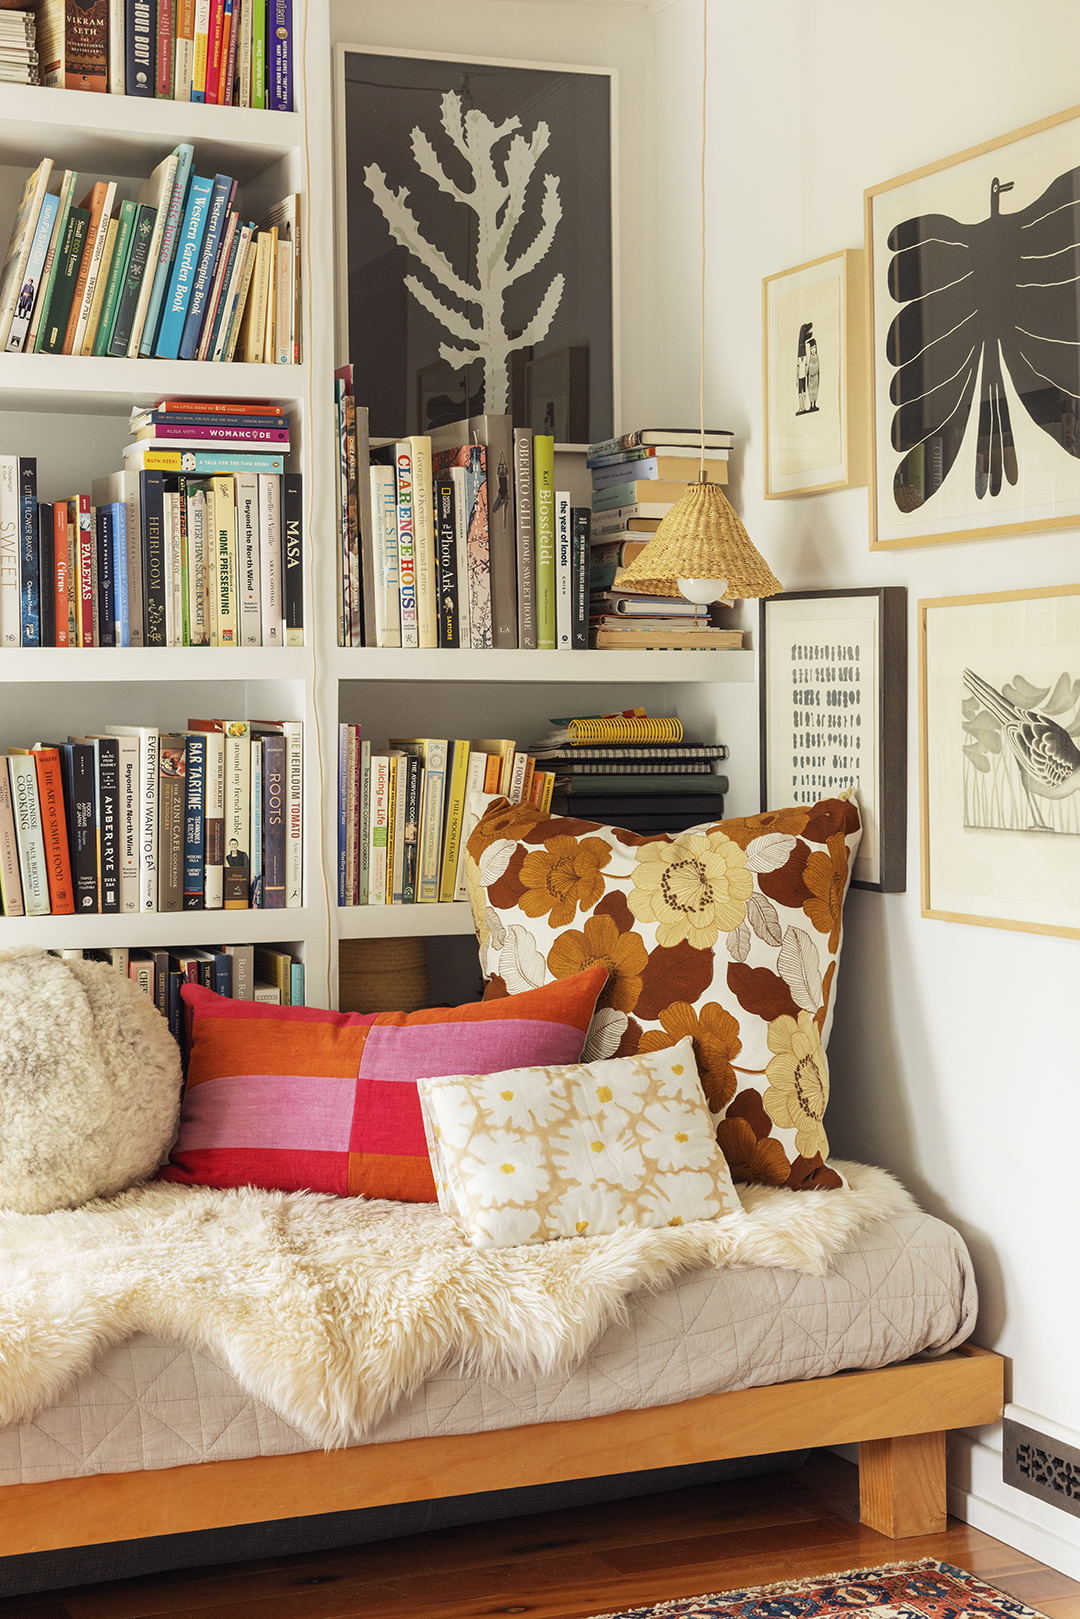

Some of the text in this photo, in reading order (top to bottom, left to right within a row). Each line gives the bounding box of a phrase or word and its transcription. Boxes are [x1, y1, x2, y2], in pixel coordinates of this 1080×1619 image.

[67, 16, 104, 26] VIKRAM
[73, 26, 98, 36] SETH
[156, 163, 178, 230] CHINESE GARDENS
[168, 183, 183, 224] artists'
[186, 196, 206, 240] Western
[208, 196, 224, 232] Western
[32, 204, 52, 265] (un)FASHION
[66, 220, 84, 277] Small ECO Houses
[160, 224, 176, 264] houses
[226, 236, 238, 266] CALIFORNIA
[44, 247, 56, 274] SHEDS
[76, 224, 98, 298] THE POTTED HERB
[86, 276, 96, 303] GARDENS
[94, 234, 104, 262] VIRGINIA
[100, 213, 108, 233] WOOLF
[178, 242, 197, 282] Garden
[192, 233, 216, 290] Landscaping
[222, 266, 232, 291] GARDENS
[172, 284, 188, 313] Book
[191, 292, 204, 316] Book
[416, 452, 426, 486] Georgia
[518, 438, 531, 530] OBERTO GILI
[418, 488, 427, 528] O'Keeffe
[540, 489, 552, 566] Blossfeldt
[150, 516, 160, 589] HEIRLOOM
[286, 520, 300, 569] MASA
[384, 480, 398, 588] THE SHELL
[398, 455, 416, 620] CLARENCE HOUSE
[558, 501, 569, 566] the year of knots
[0, 522, 17, 590] SWEET
[57, 562, 67, 592] Citrus
[82, 542, 92, 600] PALETAS
[194, 509, 205, 627] BETTER THAN STORE BOUGHT
[219, 530, 230, 614] HOME PRESERVING
[420, 568, 428, 596] Letters
[146, 736, 156, 798] EVERYTHING
[188, 742, 202, 810] BAR TARTINE
[232, 774, 240, 786] my
[291, 732, 300, 838] THE HEIRLOOM TOMATO
[376, 762, 386, 796] Juicing
[514, 766, 524, 785] FOOD
[16, 775, 30, 830] COOKING
[25, 774, 38, 830] CHEZ PANISSE
[234, 787, 242, 814] french
[268, 774, 281, 825] ROOTS
[377, 808, 386, 825] Life
[430, 780, 438, 822] NOURISHING
[44, 770, 64, 881] THE ART OF SIMPLE FOOD
[104, 796, 114, 871] AMBER RYE
[144, 806, 154, 837] WANT
[194, 816, 202, 844] TECHNIQUES
[234, 816, 242, 835] table
[144, 839, 154, 852] TO
[145, 854, 156, 872] EAT
[448, 842, 456, 863] FEAST
[28, 842, 40, 897] PAUL BERTOLLI
